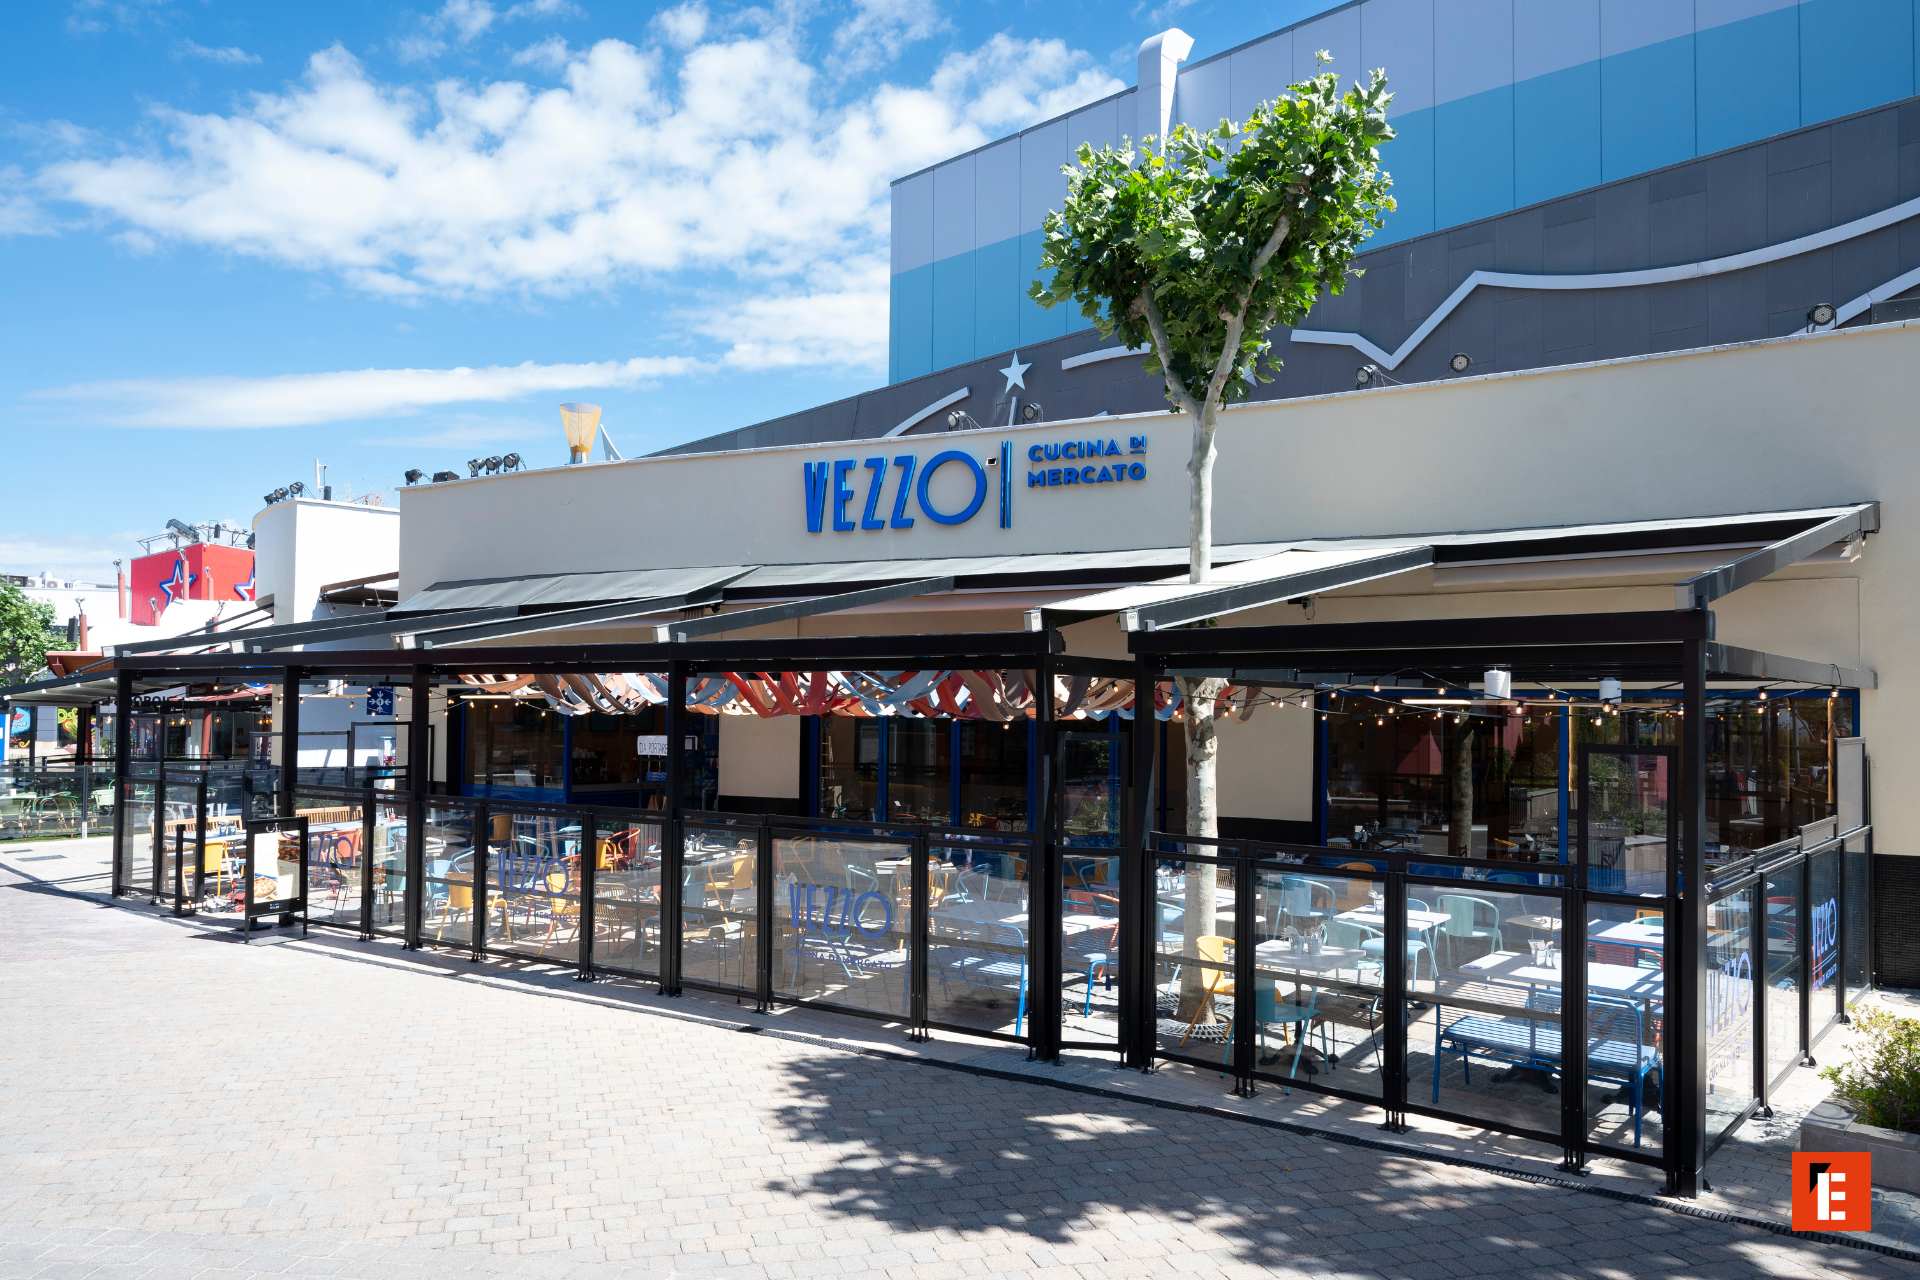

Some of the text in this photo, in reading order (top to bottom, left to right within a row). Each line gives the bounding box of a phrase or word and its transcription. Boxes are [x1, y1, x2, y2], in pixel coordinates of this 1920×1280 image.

[1028, 436, 1147, 462] CUCINA DI
[803, 450, 987, 533] VEZZO
[1028, 462, 1147, 488] MERCATO
[308, 832, 354, 871] EZZO
[497, 851, 569, 897] VEZZO
[789, 883, 891, 939] VEZZO
[1811, 898, 1837, 960] VEZZO
[788, 947, 825, 960] CUCINA
[842, 956, 892, 970] MERCATO
[1709, 952, 1751, 1038] VEZZO
